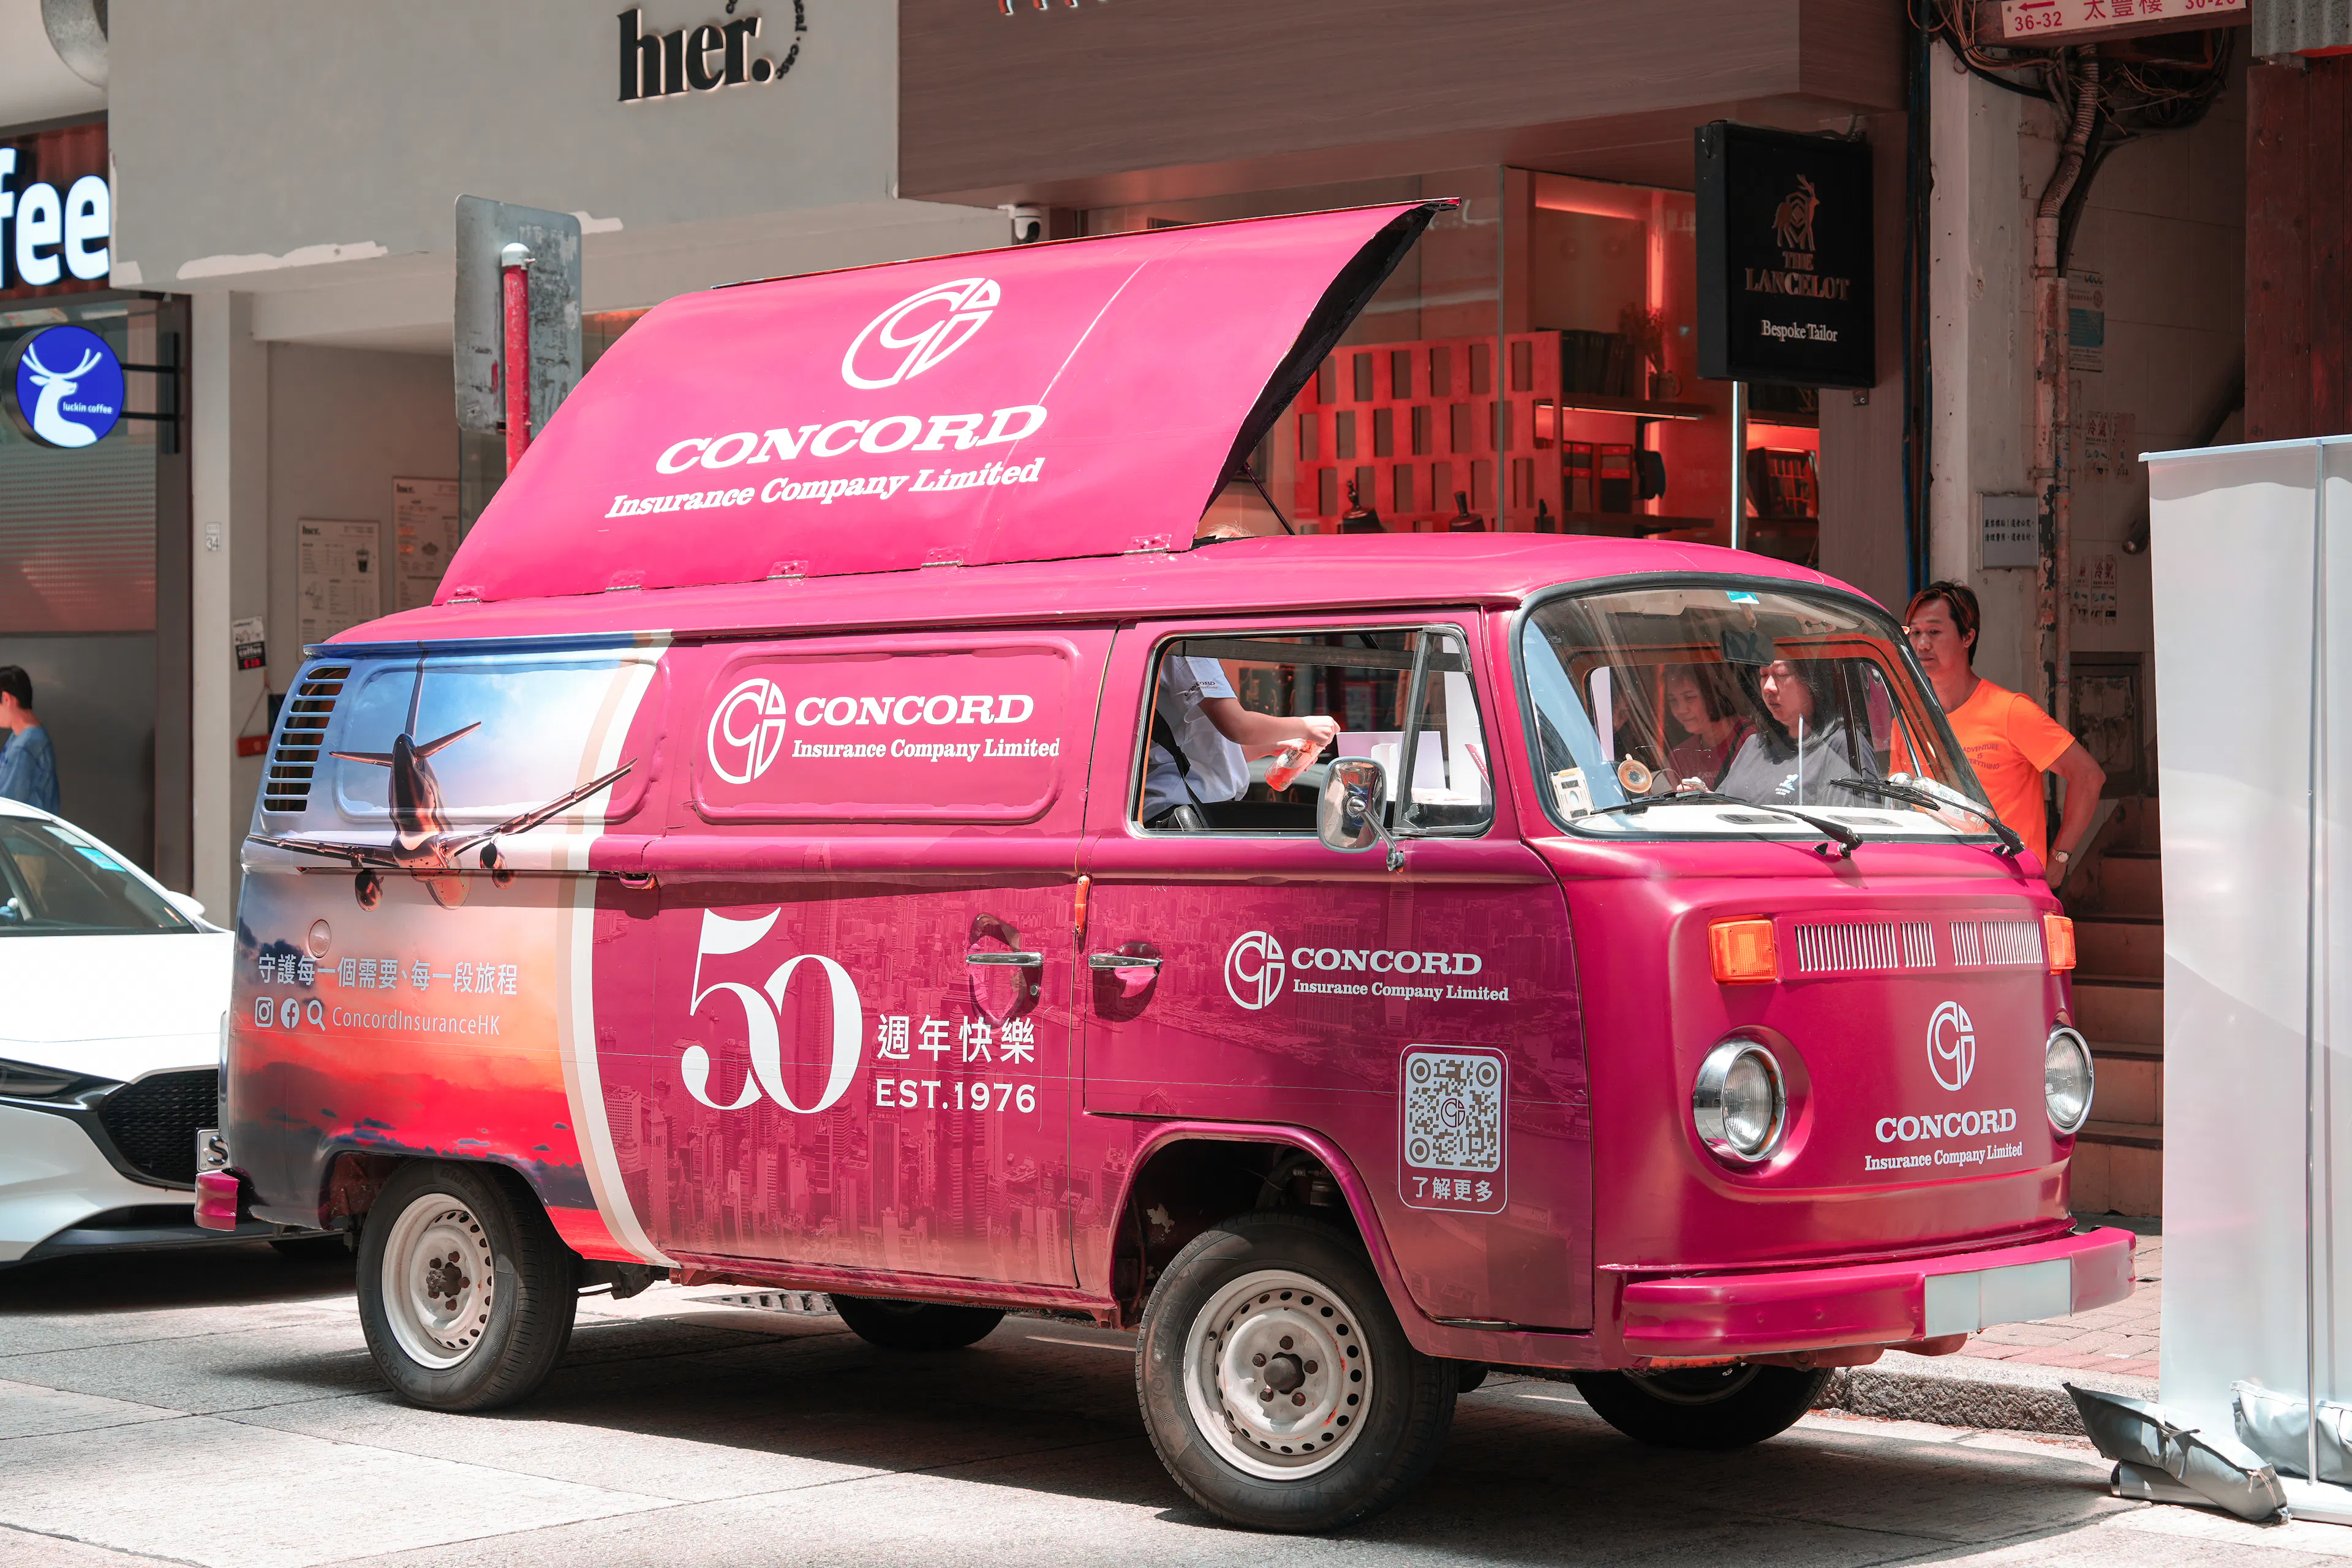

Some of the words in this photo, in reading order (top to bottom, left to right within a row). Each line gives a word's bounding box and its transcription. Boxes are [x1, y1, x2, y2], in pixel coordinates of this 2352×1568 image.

[2015, 11, 2063, 32] 36-32
[1782, 251, 1814, 271] THE
[1744, 268, 1850, 300] LANCELOT
[1760, 319, 1806, 342] Bespoke
[1807, 323, 1838, 342] Tailor
[62, 401, 86, 413] luckin
[87, 404, 113, 415] coffee
[655, 404, 1048, 475] CONCORD
[605, 485, 755, 518] Insurance
[761, 473, 911, 505] Company
[908, 457, 1046, 492] Limited
[795, 695, 1034, 726] CONCORD
[791, 739, 886, 758] Insurance
[891, 739, 981, 763] Company
[982, 737, 1060, 758] Limited
[1963, 743, 1999, 753] ADVENTURE
[1968, 758, 2000, 769] ERYTHING
[258, 953, 518, 995] 守護每一個需要、每一段旅程
[1291, 947, 1482, 976] CONCORD
[1293, 979, 1368, 995] Insurance
[1371, 982, 1443, 1002] Company
[1446, 985, 1509, 1001] Limited
[333, 1006, 500, 1036] ConcordInsuranceHK
[681, 907, 863, 1114] 50
[877, 1014, 1035, 1065] 週年快樂
[876, 1078, 1036, 1114] EST.1976
[1875, 1108, 2017, 1144] CONCORD
[1864, 1155, 1932, 1171] Insurance
[1934, 1149, 1986, 1167] Company
[1986, 1141, 2023, 1159] Limited
[1412, 1176, 1493, 1202] 了解更多
